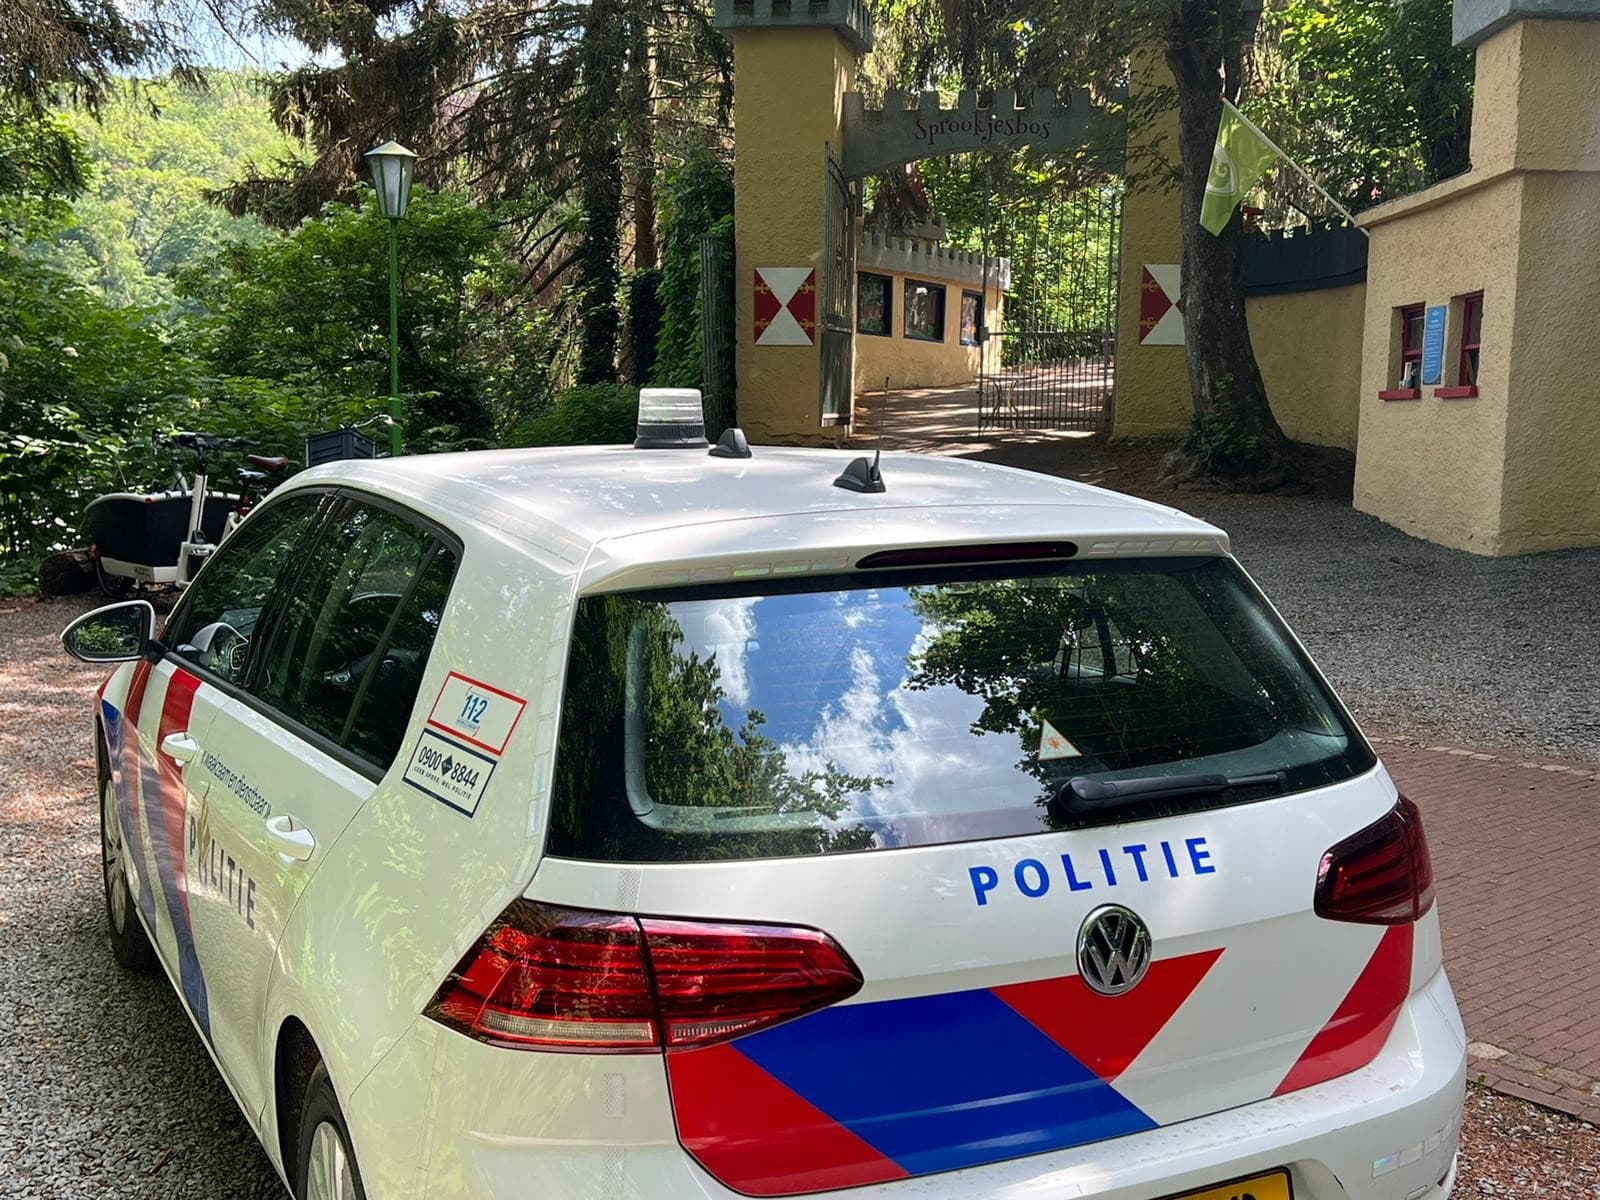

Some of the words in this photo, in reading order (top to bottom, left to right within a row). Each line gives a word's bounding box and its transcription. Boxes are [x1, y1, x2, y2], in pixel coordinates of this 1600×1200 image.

[914, 110, 1050, 145] Sprookjesbos
[418, 745, 443, 771] 0900
[450, 761, 480, 791] 8844
[968, 836, 1216, 906] POLITIE
[1080, 908, 1149, 992] VW
